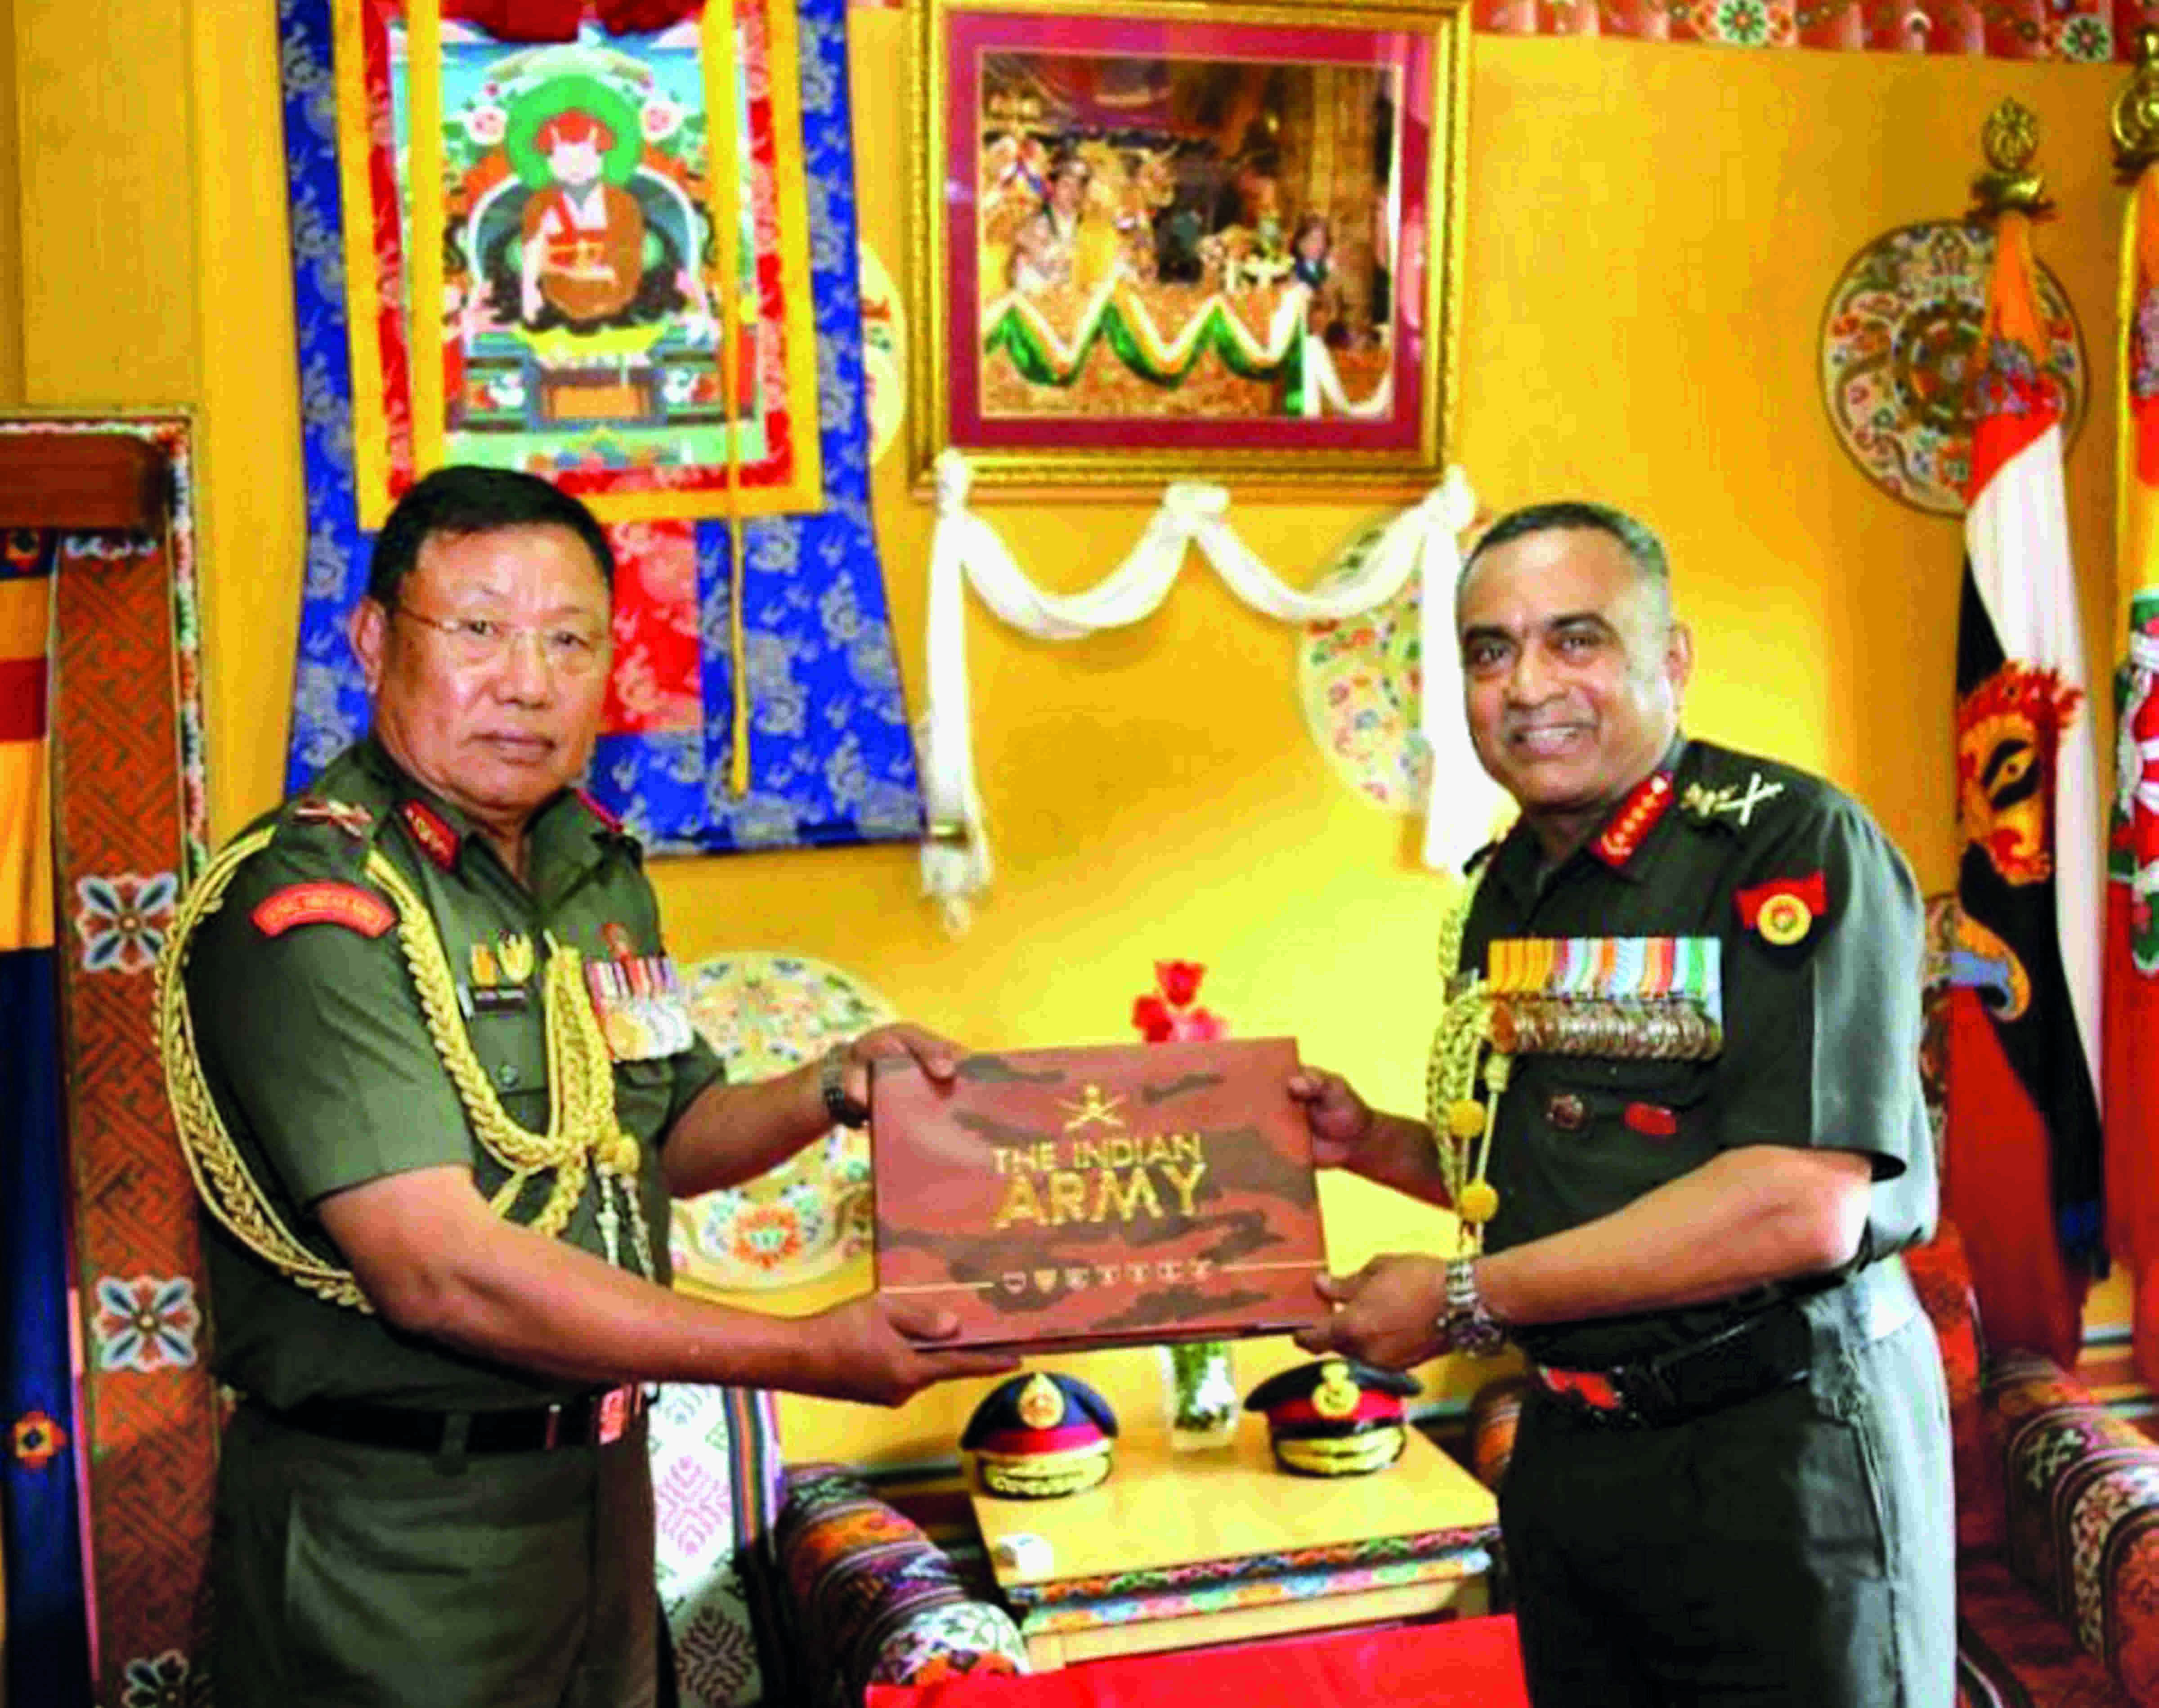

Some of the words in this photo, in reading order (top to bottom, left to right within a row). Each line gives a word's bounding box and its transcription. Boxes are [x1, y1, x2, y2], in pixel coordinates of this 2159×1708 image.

[993, 1141, 1055, 1174] THE
[1074, 1133, 1201, 1168] INDIAN
[994, 1163, 1207, 1229] ARMY
